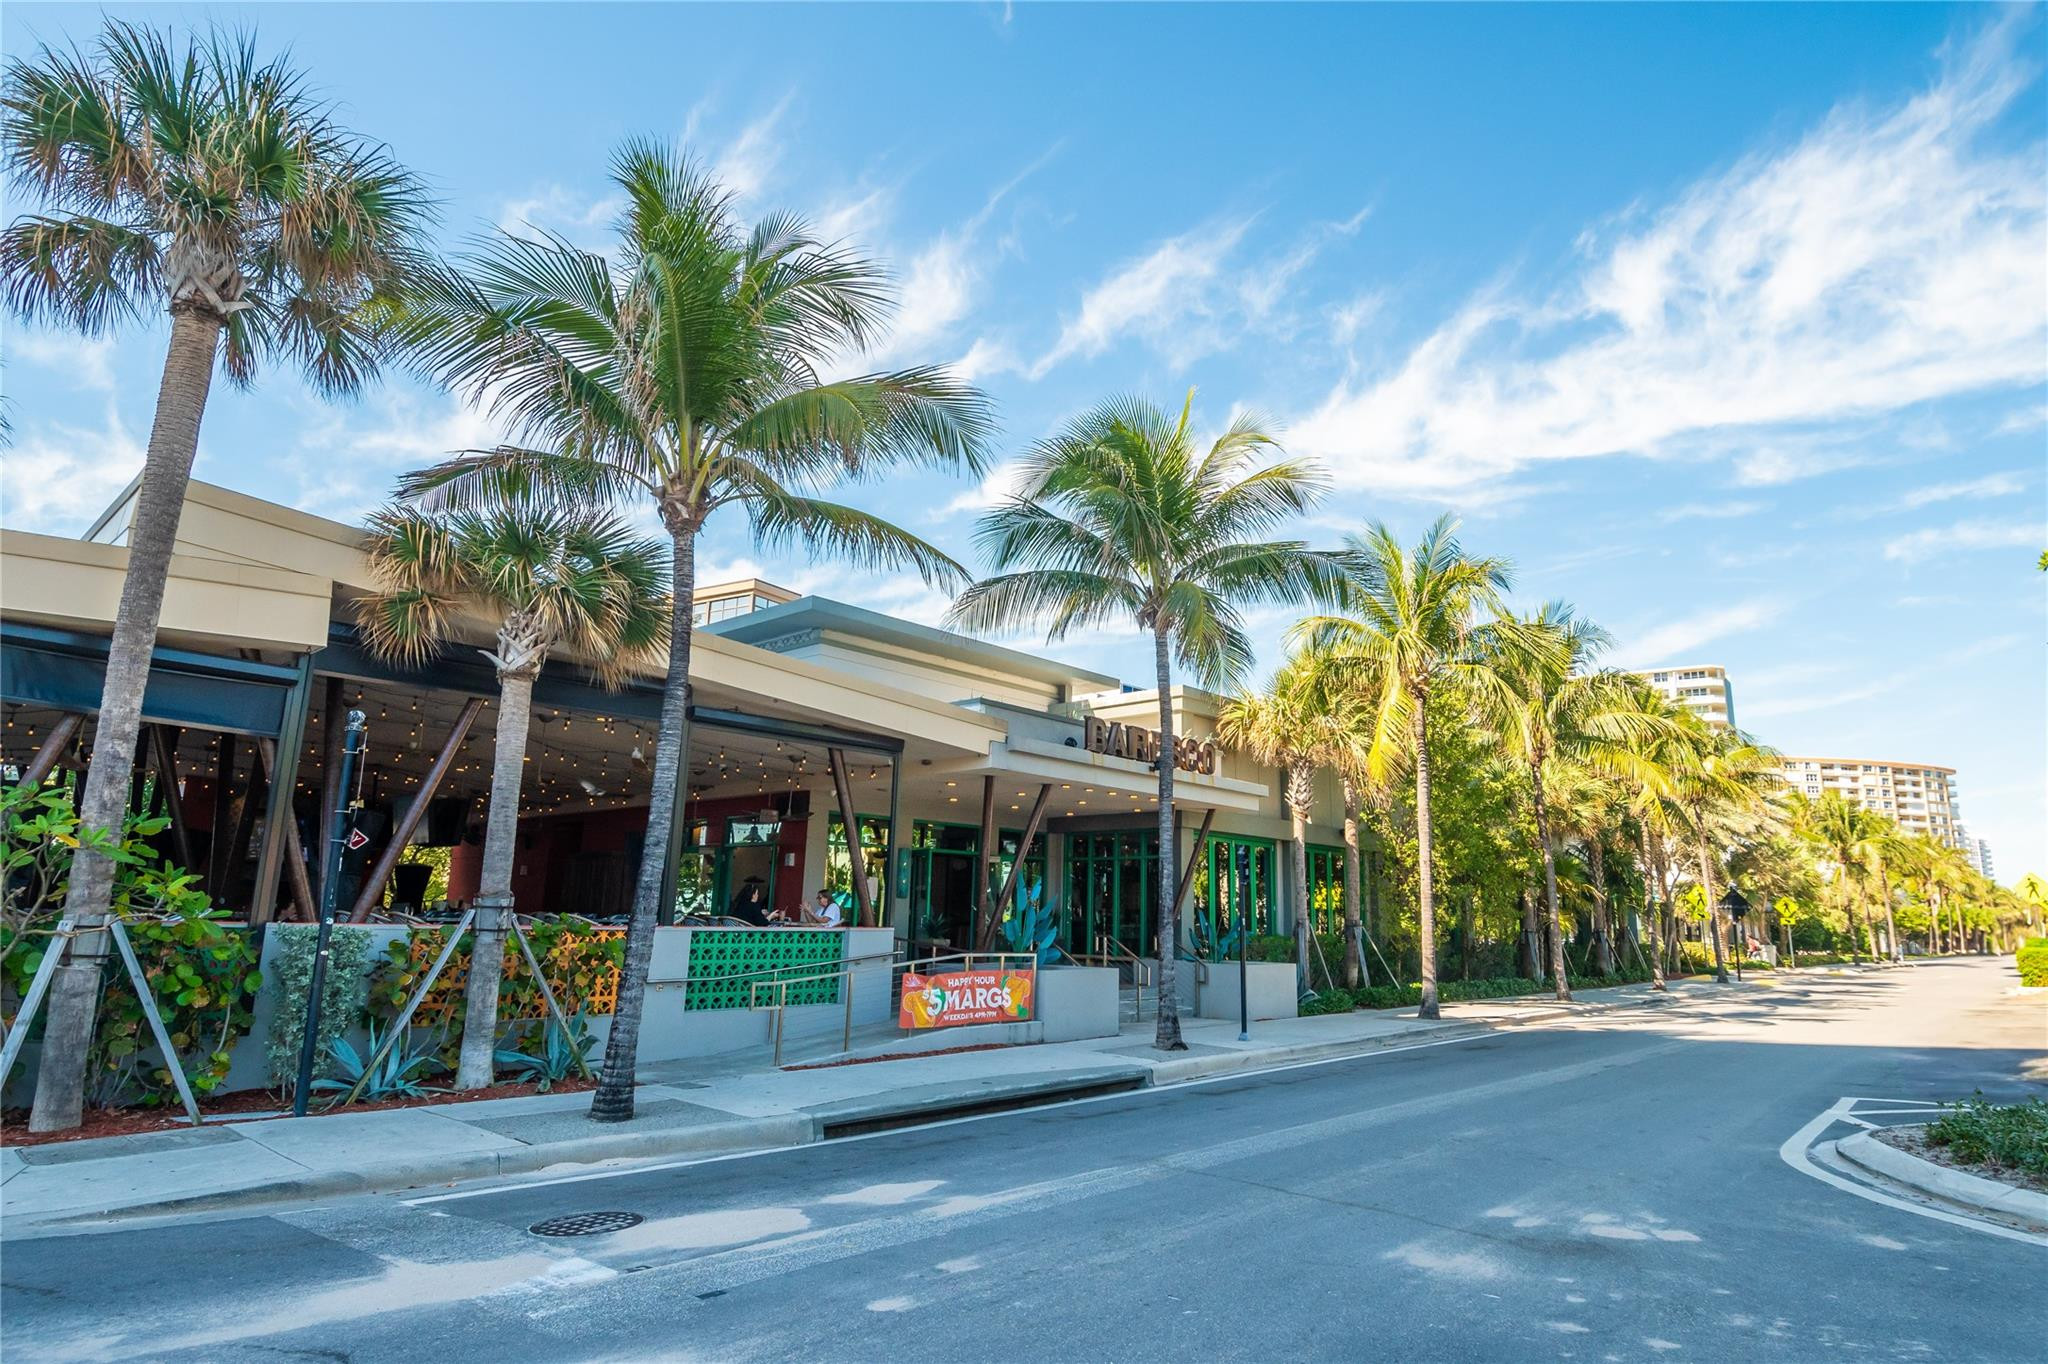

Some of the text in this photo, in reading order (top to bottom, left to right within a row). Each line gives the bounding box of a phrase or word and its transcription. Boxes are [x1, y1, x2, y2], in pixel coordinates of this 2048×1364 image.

[947, 976, 996, 987] HAPPY HOUR
[922, 987, 1012, 1016] $5 MARGS
